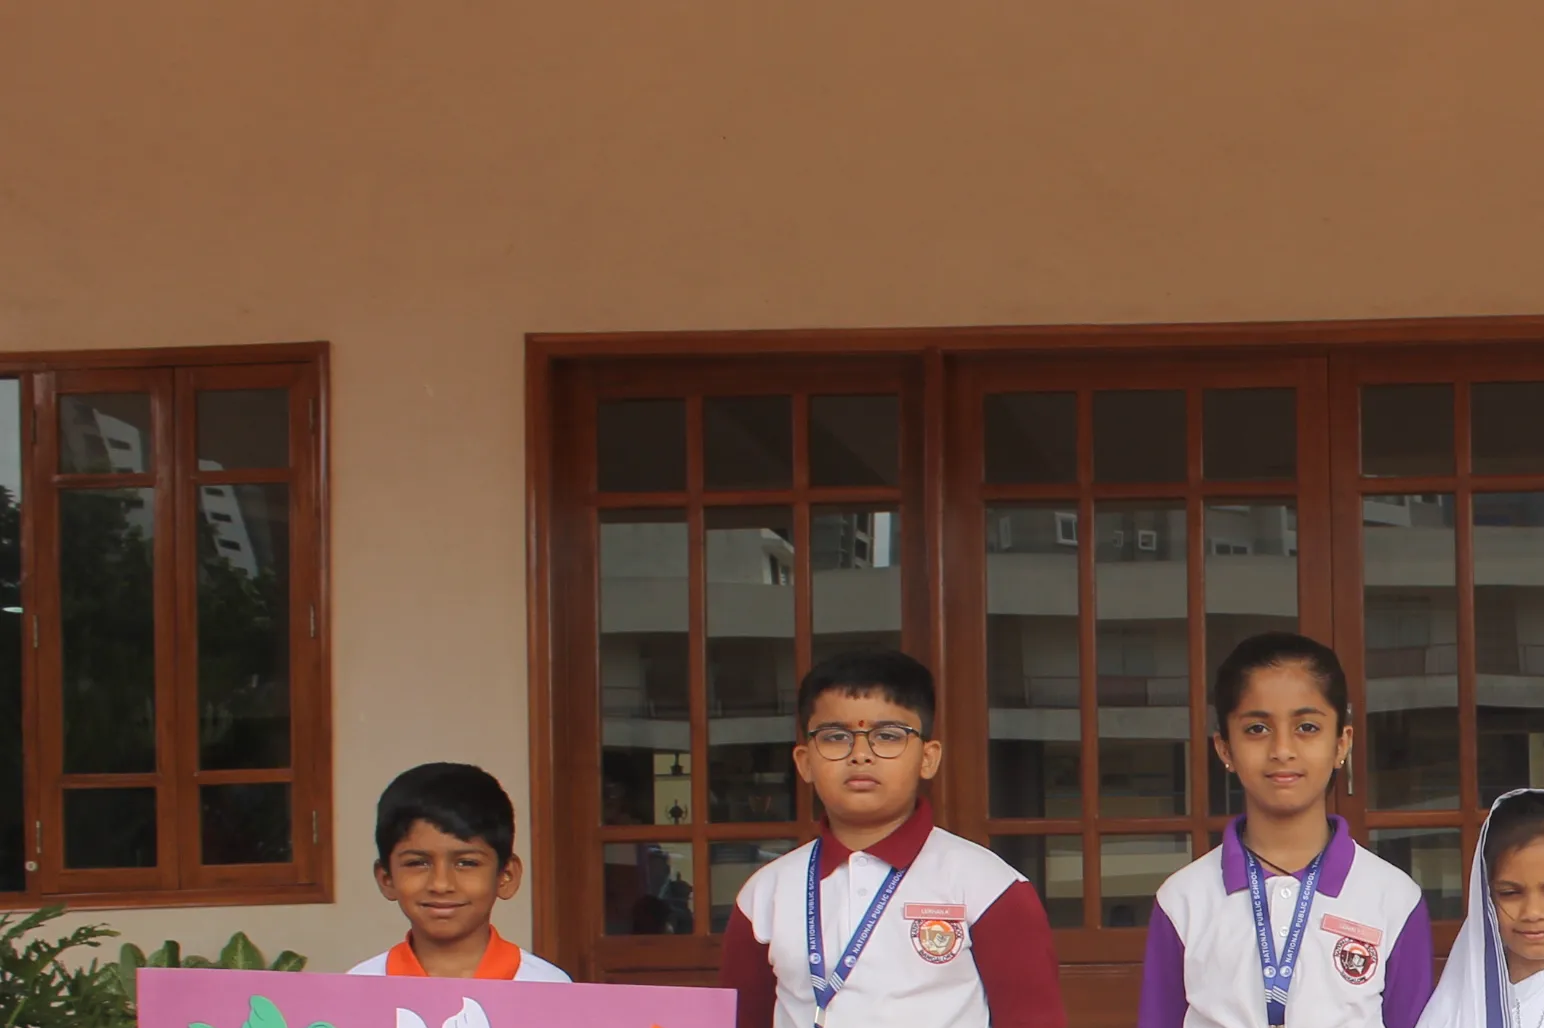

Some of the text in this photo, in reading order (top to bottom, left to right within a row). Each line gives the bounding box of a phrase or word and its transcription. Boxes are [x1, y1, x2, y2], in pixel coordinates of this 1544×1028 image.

[852, 923, 875, 954] NATIONAL
[872, 893, 889, 919] PUBLIC
[1254, 900, 1265, 927] PUBLIC
[808, 915, 817, 950] NATIONAL
[1258, 927, 1271, 963] NATIONAL
[1285, 928, 1300, 964] NATIONAL
[1295, 901, 1308, 928] PUBLIC
